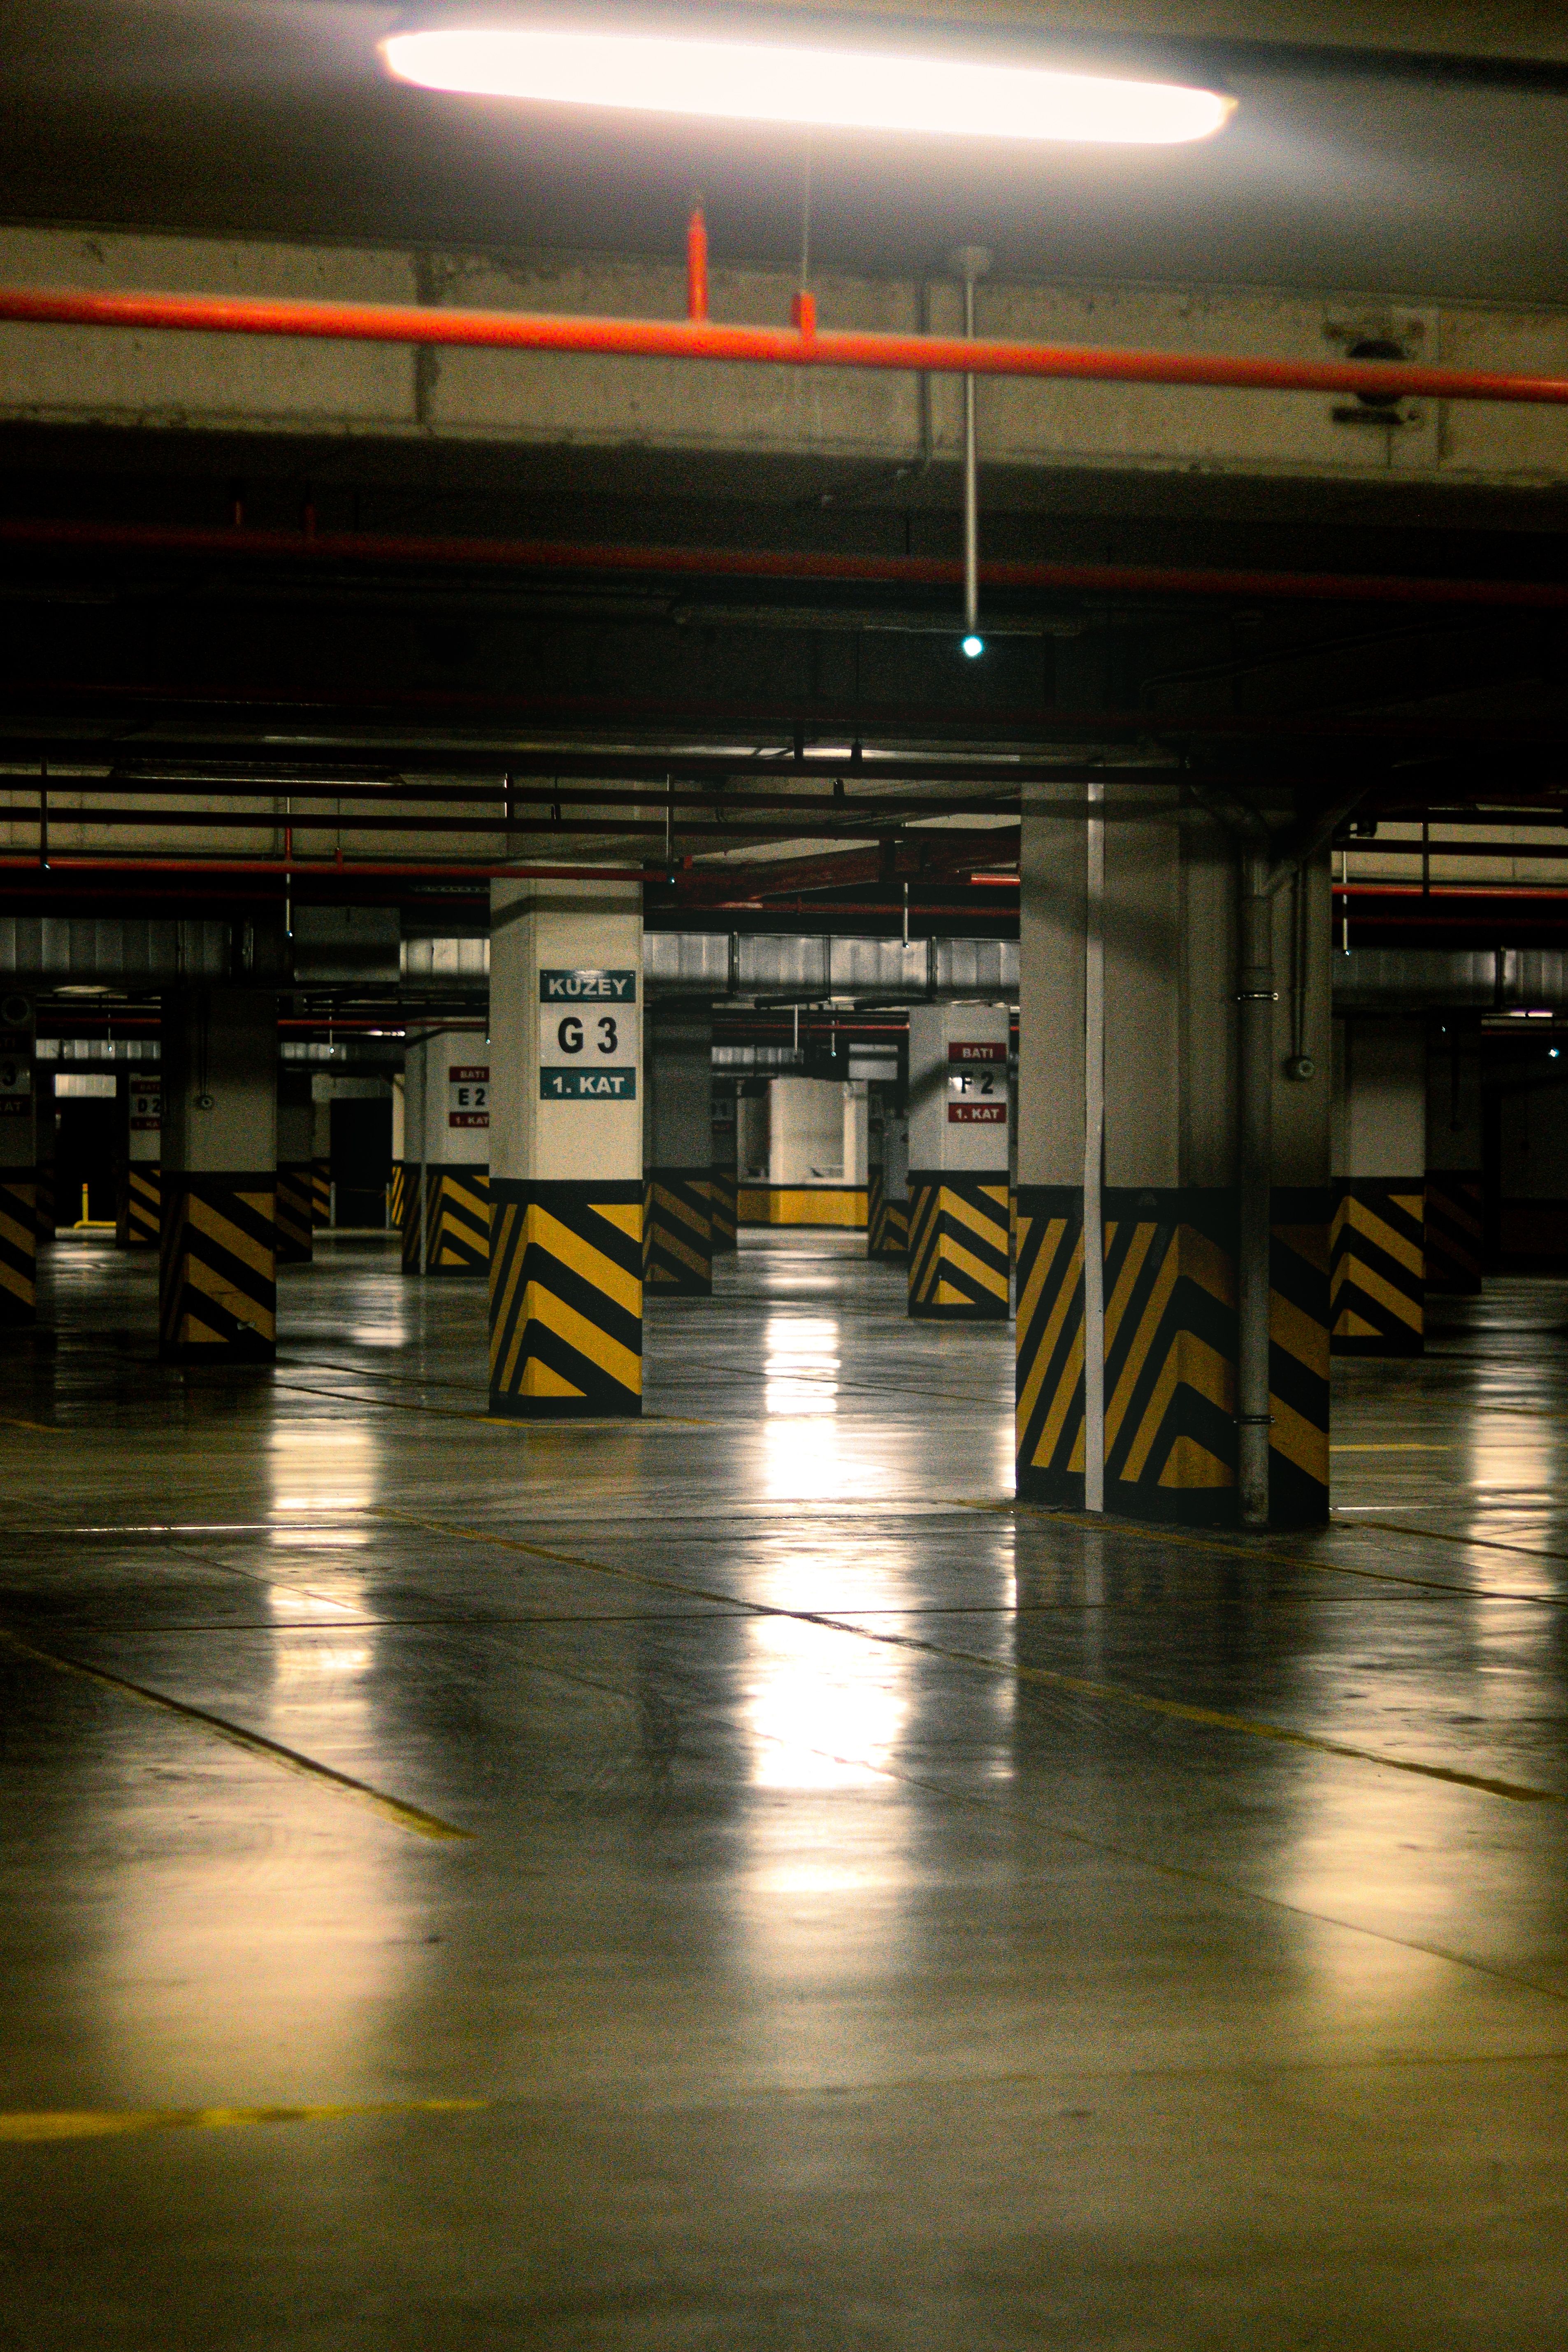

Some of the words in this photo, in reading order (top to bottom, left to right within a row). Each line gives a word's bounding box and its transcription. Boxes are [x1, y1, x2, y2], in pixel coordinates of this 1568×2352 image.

[549, 979, 627, 995] KUZEY
[962, 1048, 993, 1059] BATI
[553, 1076, 571, 1093] 1.
[580, 1077, 625, 1093] KAT
[955, 1108, 968, 1119] 1.
[972, 1108, 999, 1119] KAT
